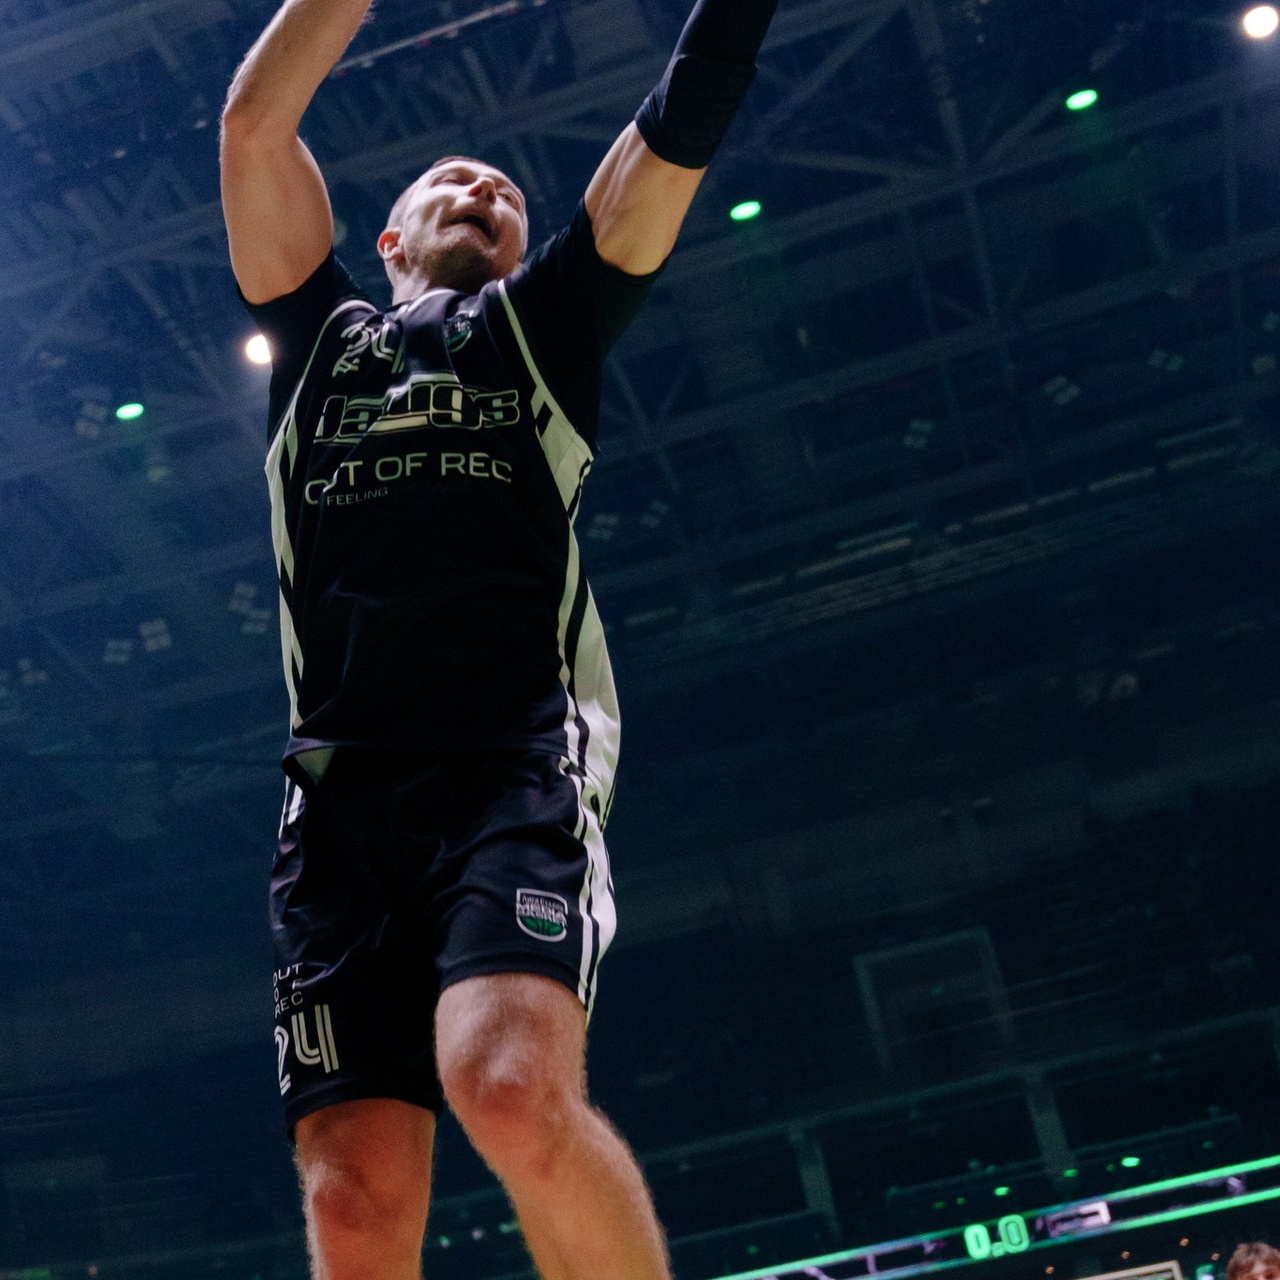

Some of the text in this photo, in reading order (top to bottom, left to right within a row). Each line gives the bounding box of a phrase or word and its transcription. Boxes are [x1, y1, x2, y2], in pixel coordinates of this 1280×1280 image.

[375, 452, 428, 483] OF
[440, 452, 513, 485] REC
[326, 486, 390, 507] FEELING
[273, 962, 303, 987] OUT
[274, 1003, 340, 1097] 24
[963, 1214, 1031, 1261] 0.0
